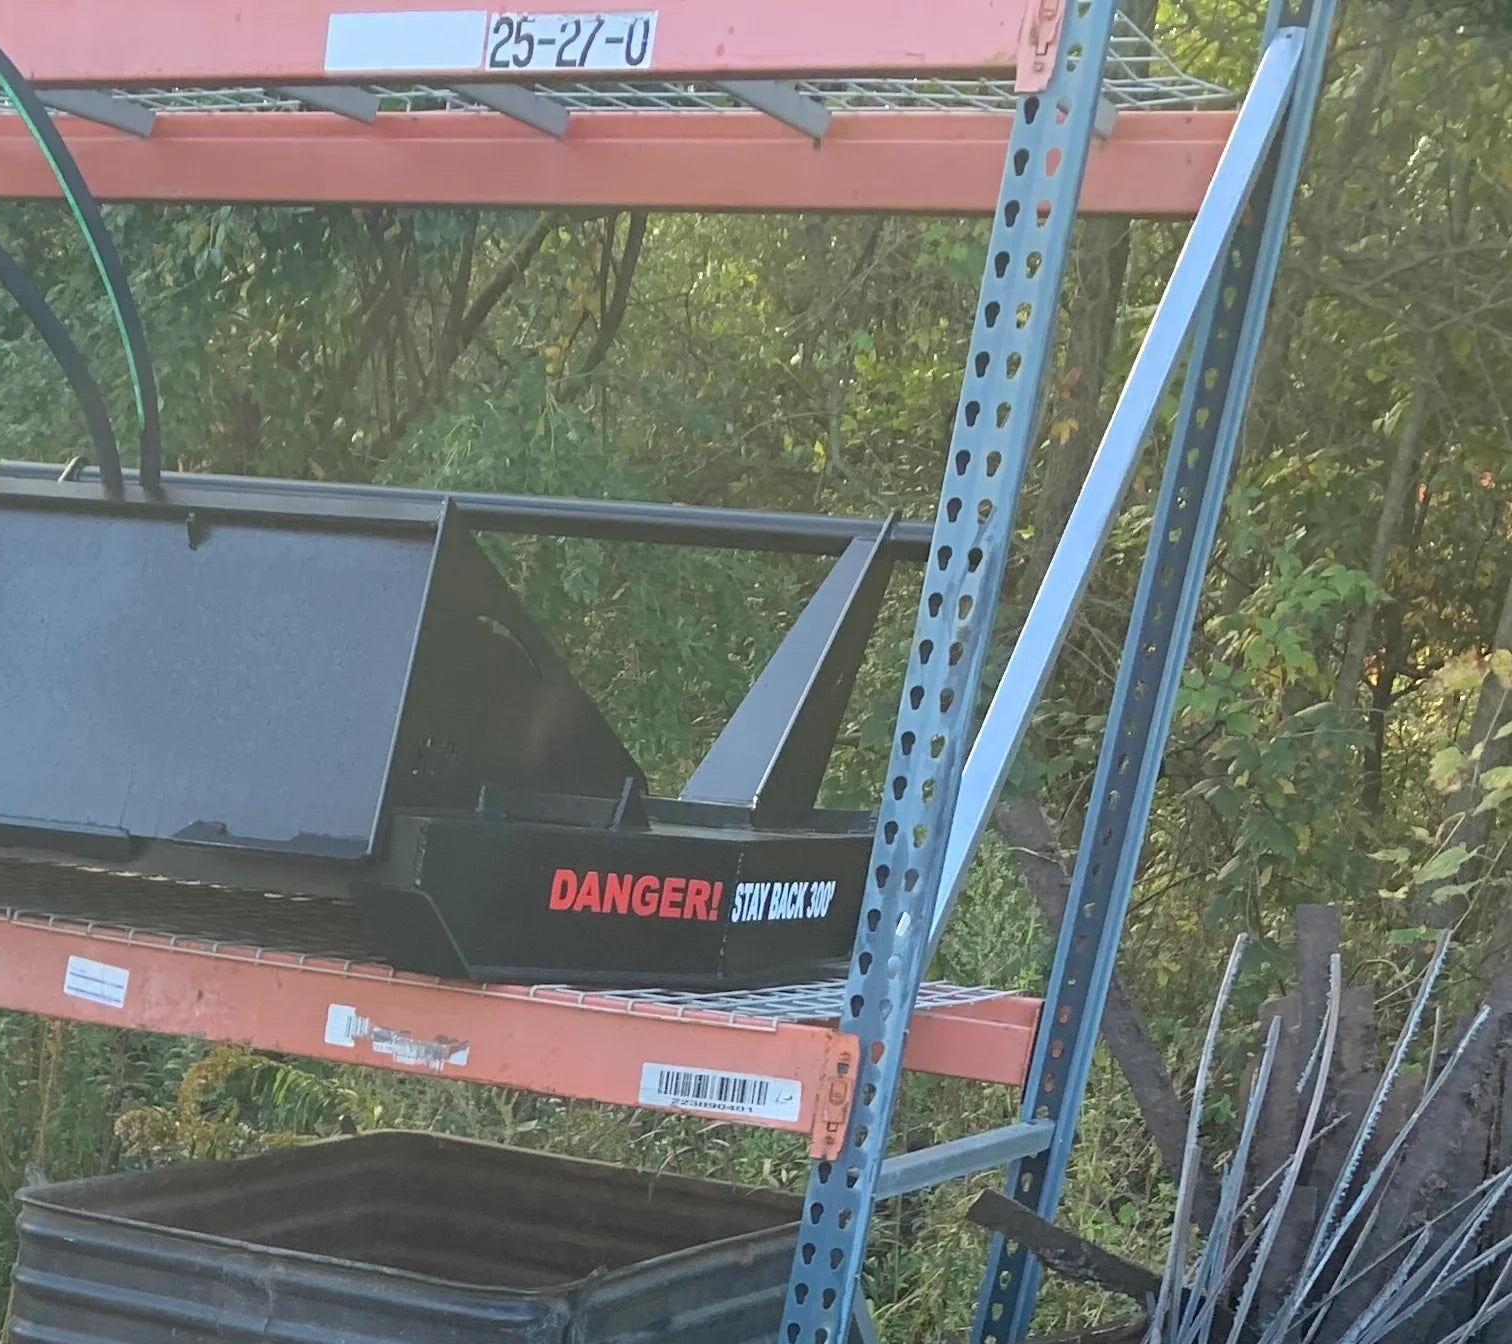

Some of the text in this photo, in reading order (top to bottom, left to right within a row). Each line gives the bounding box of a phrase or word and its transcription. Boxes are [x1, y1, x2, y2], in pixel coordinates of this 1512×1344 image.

[490, 14, 650, 68] 25-27-0
[549, 868, 724, 922] DANGER!
[731, 882, 771, 922] STAY
[767, 881, 809, 920] BACK
